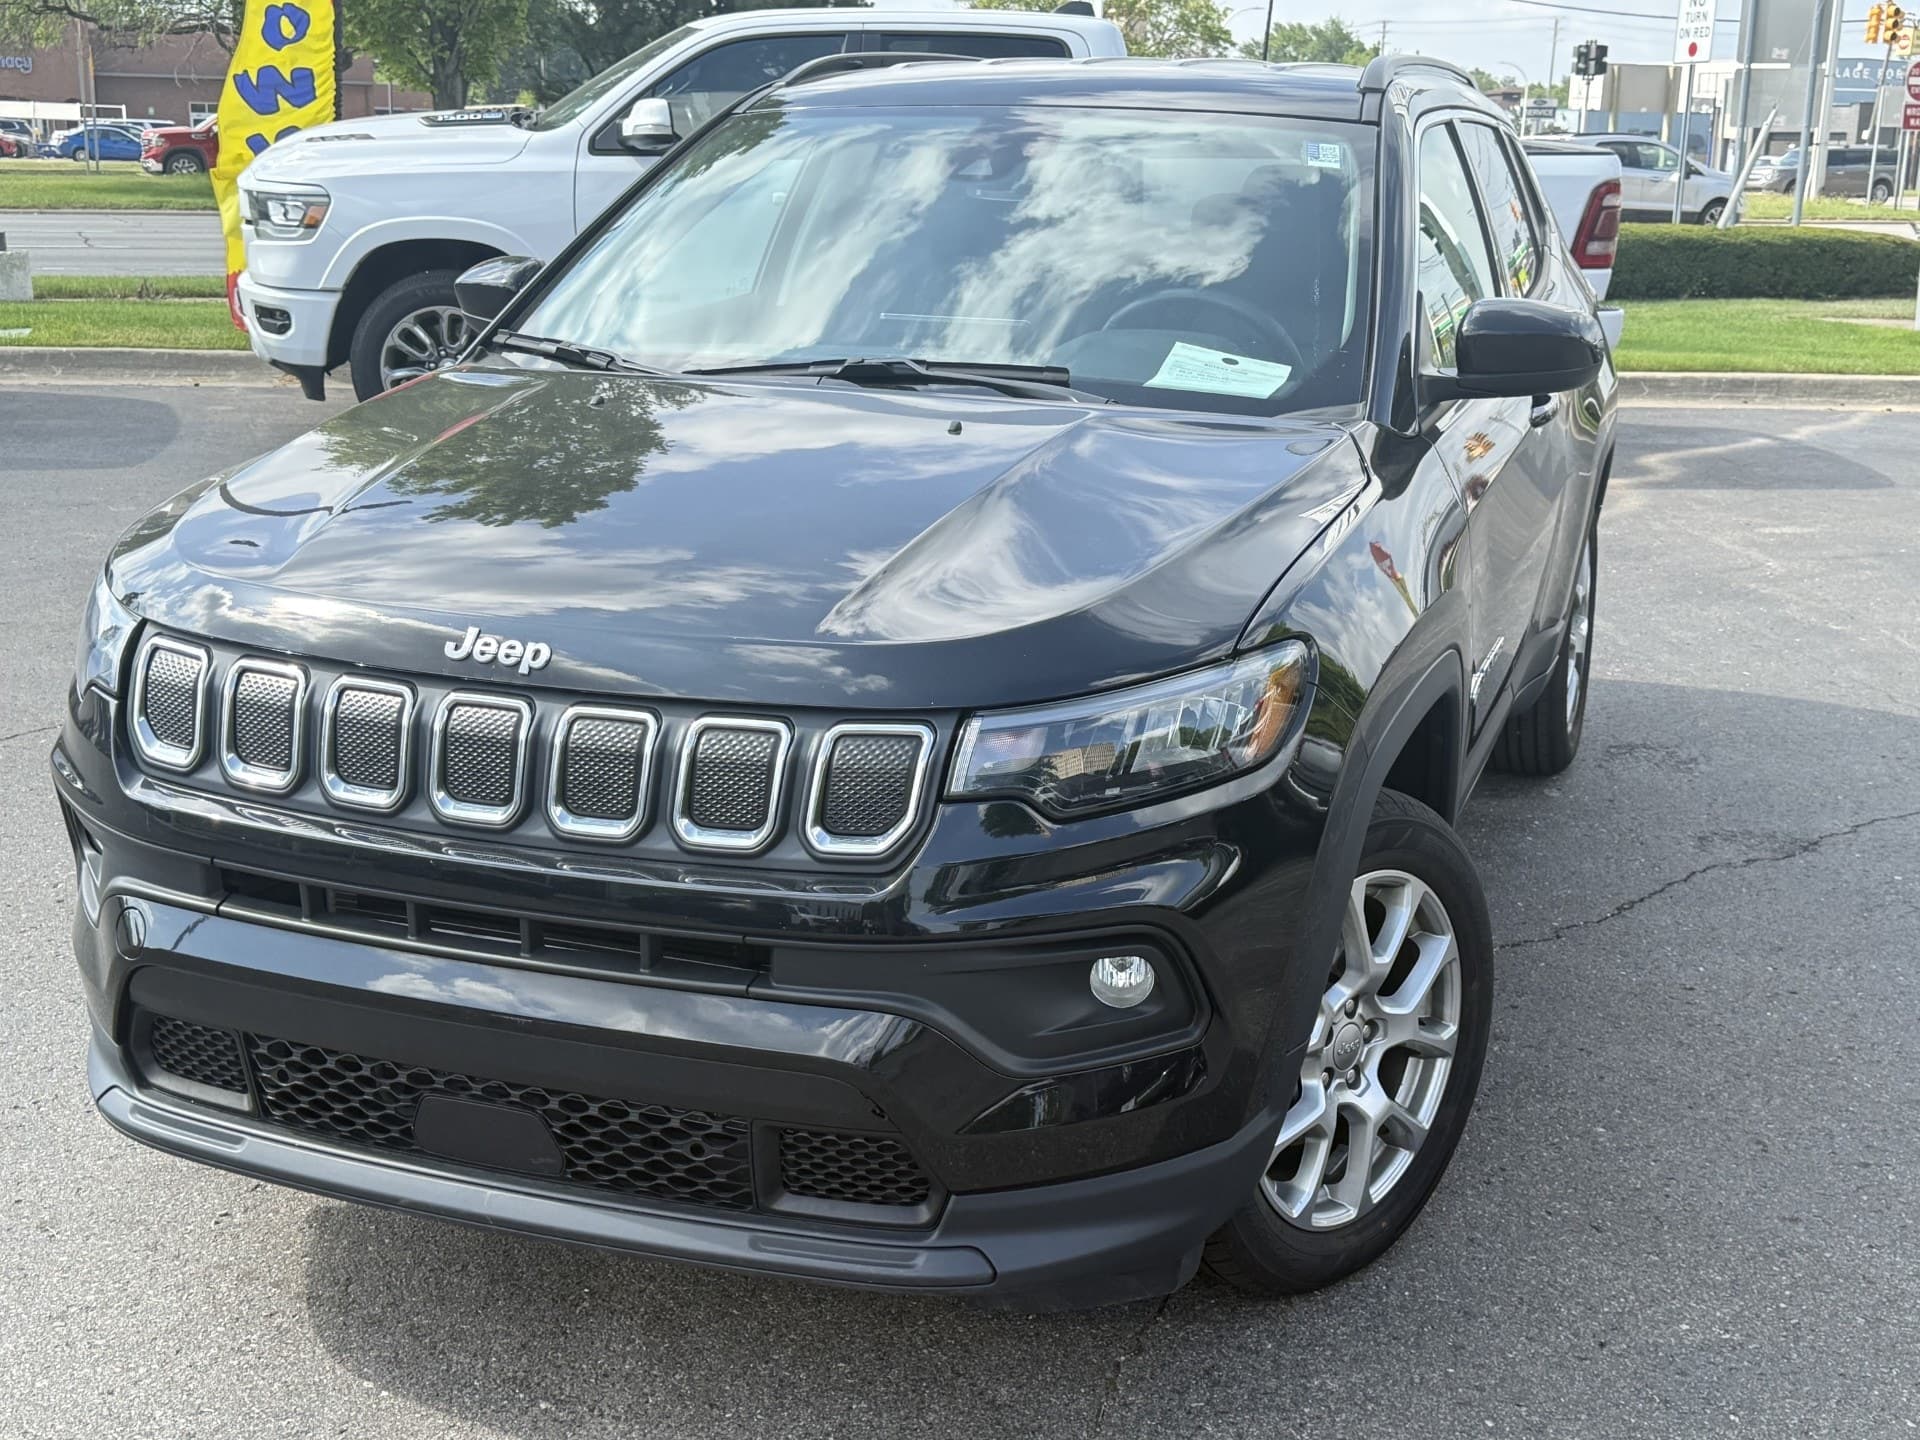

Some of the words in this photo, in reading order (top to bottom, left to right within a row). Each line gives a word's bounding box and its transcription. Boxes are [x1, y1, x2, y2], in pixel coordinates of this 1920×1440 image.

[1685, 10, 1709, 23] TURN
[1679, 27, 1691, 39] ON
[1693, 26, 1710, 38] RED
[444, 626, 552, 675] Jeep
[1337, 1039, 1360, 1055] Jeep
